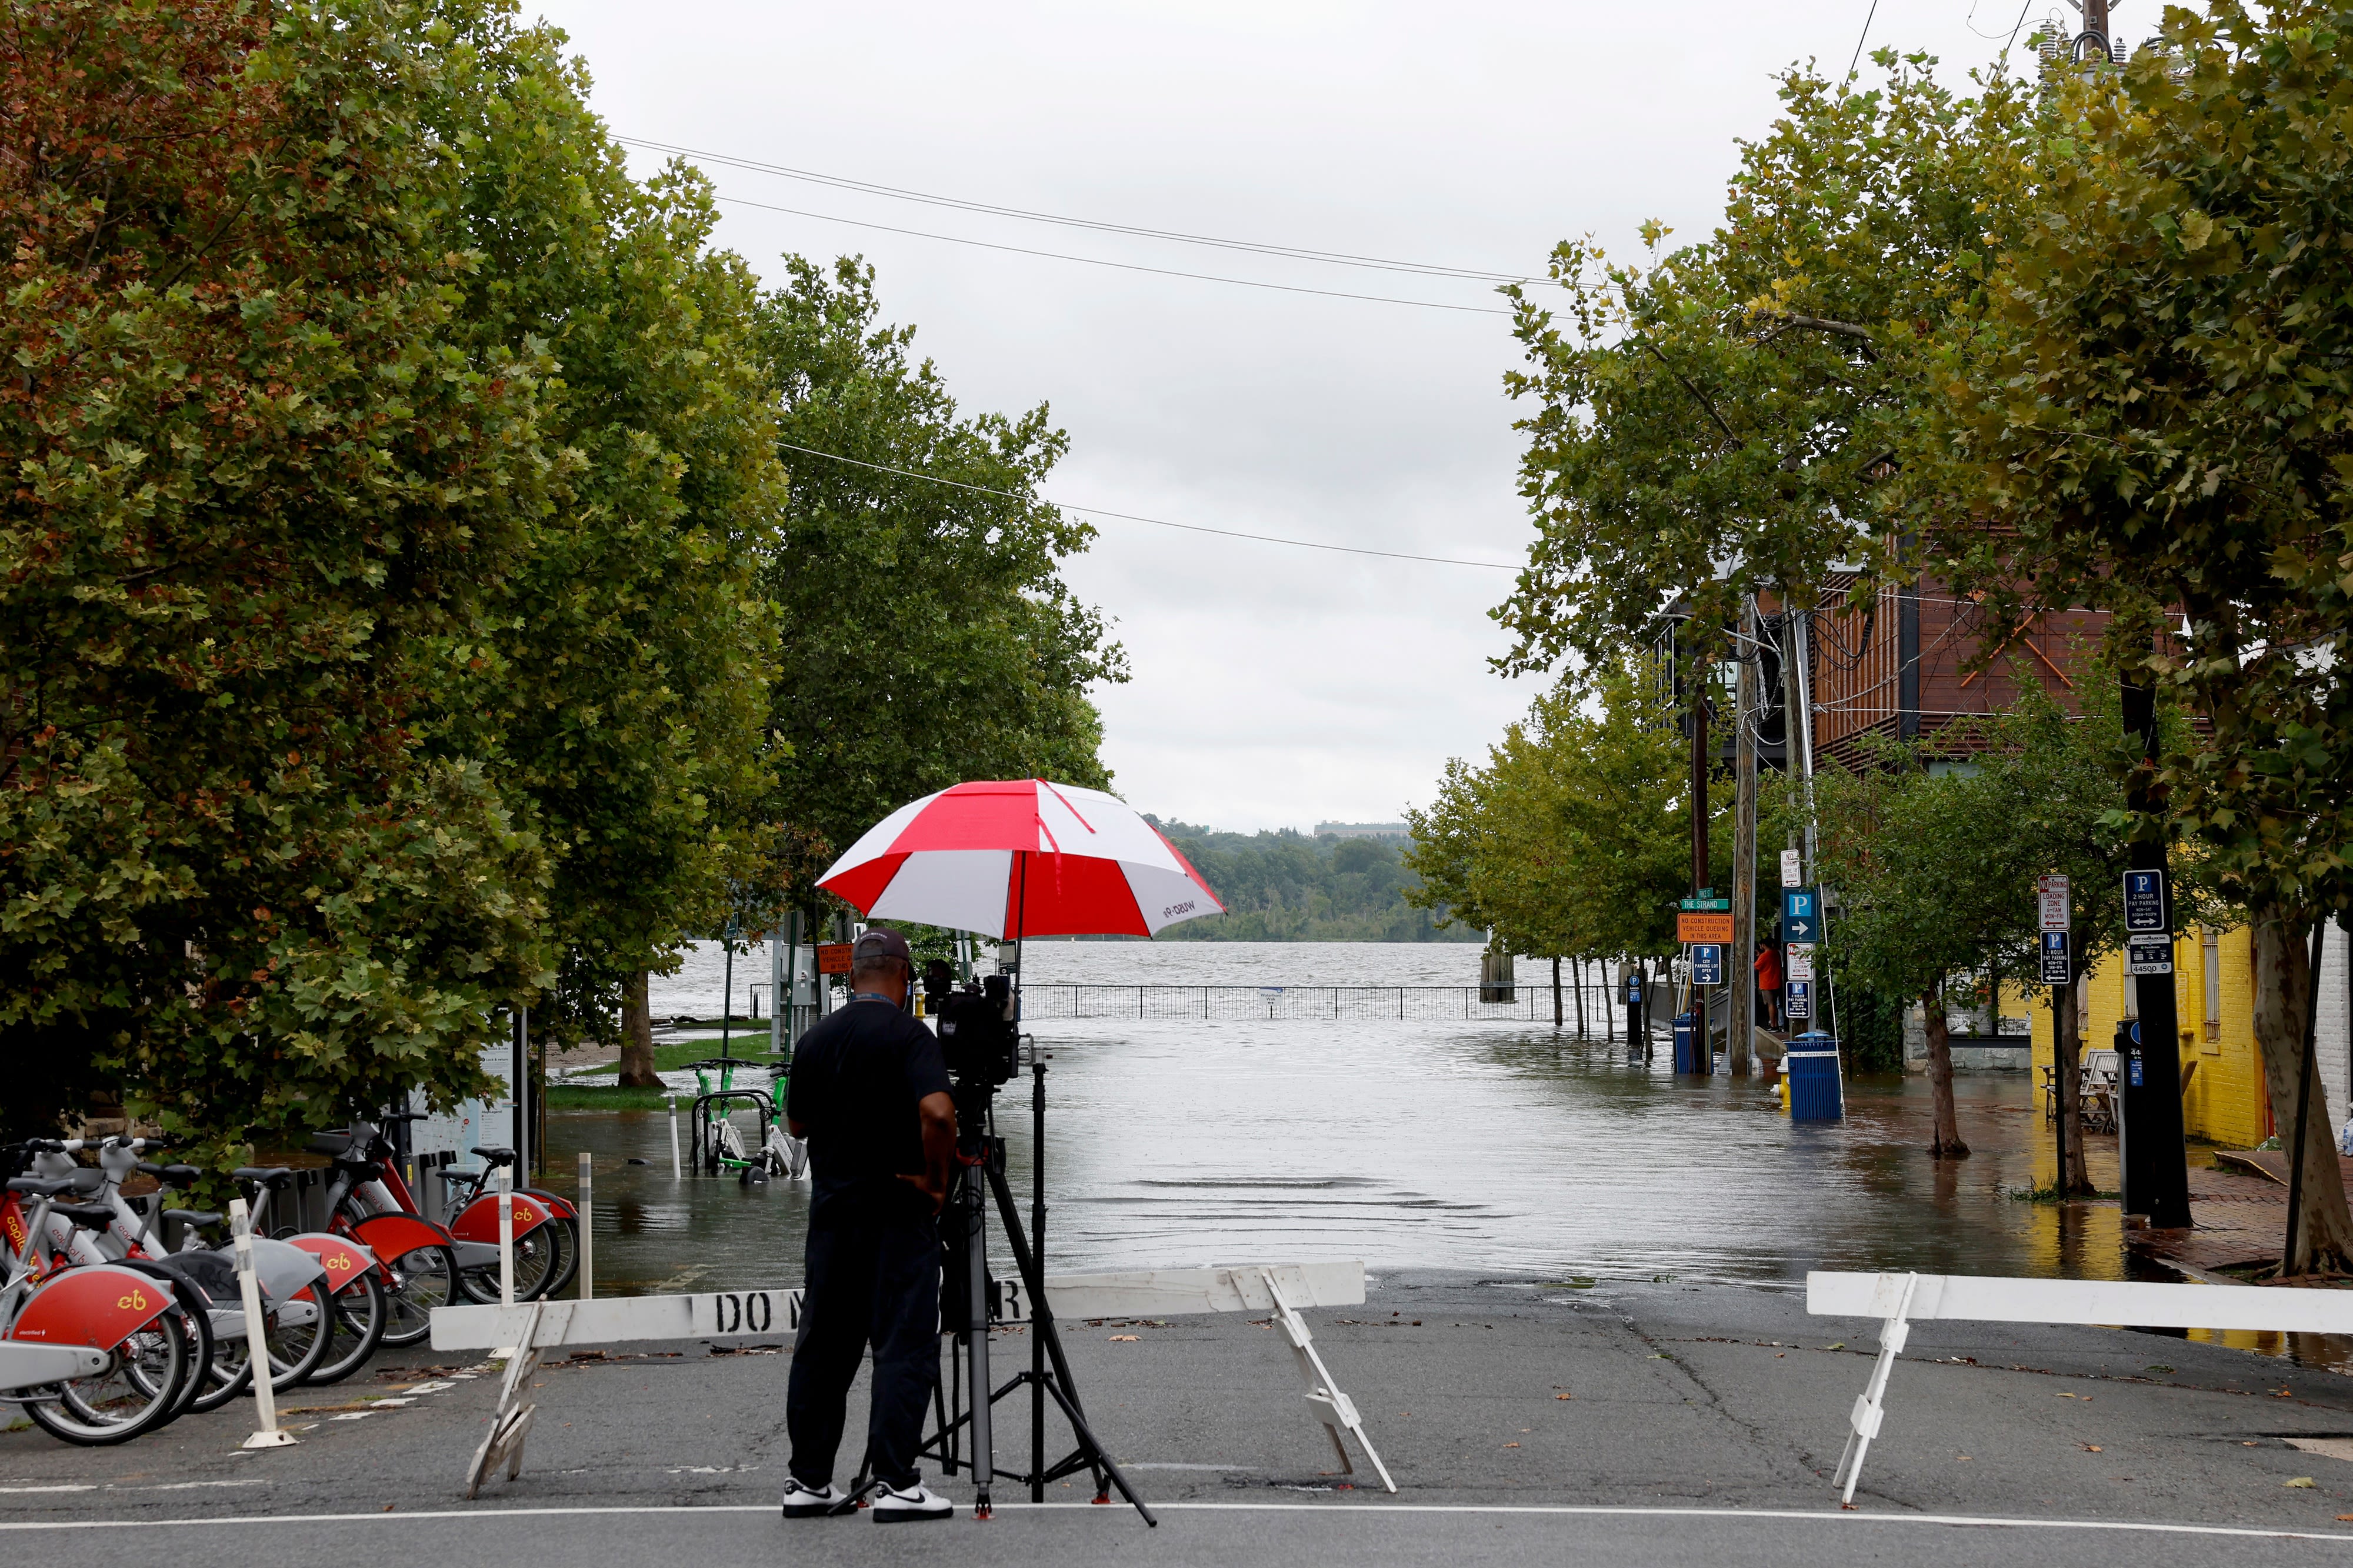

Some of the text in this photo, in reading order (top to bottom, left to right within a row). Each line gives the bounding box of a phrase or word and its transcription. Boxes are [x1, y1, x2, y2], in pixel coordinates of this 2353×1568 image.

[2040, 880, 2048, 890] NO
[2137, 876, 2148, 891] P
[1793, 896, 1807, 914] P
[2050, 934, 2059, 947] P
[1703, 948, 1709, 957] P
[1794, 984, 1802, 993] P
[716, 1292, 771, 1332] DO
